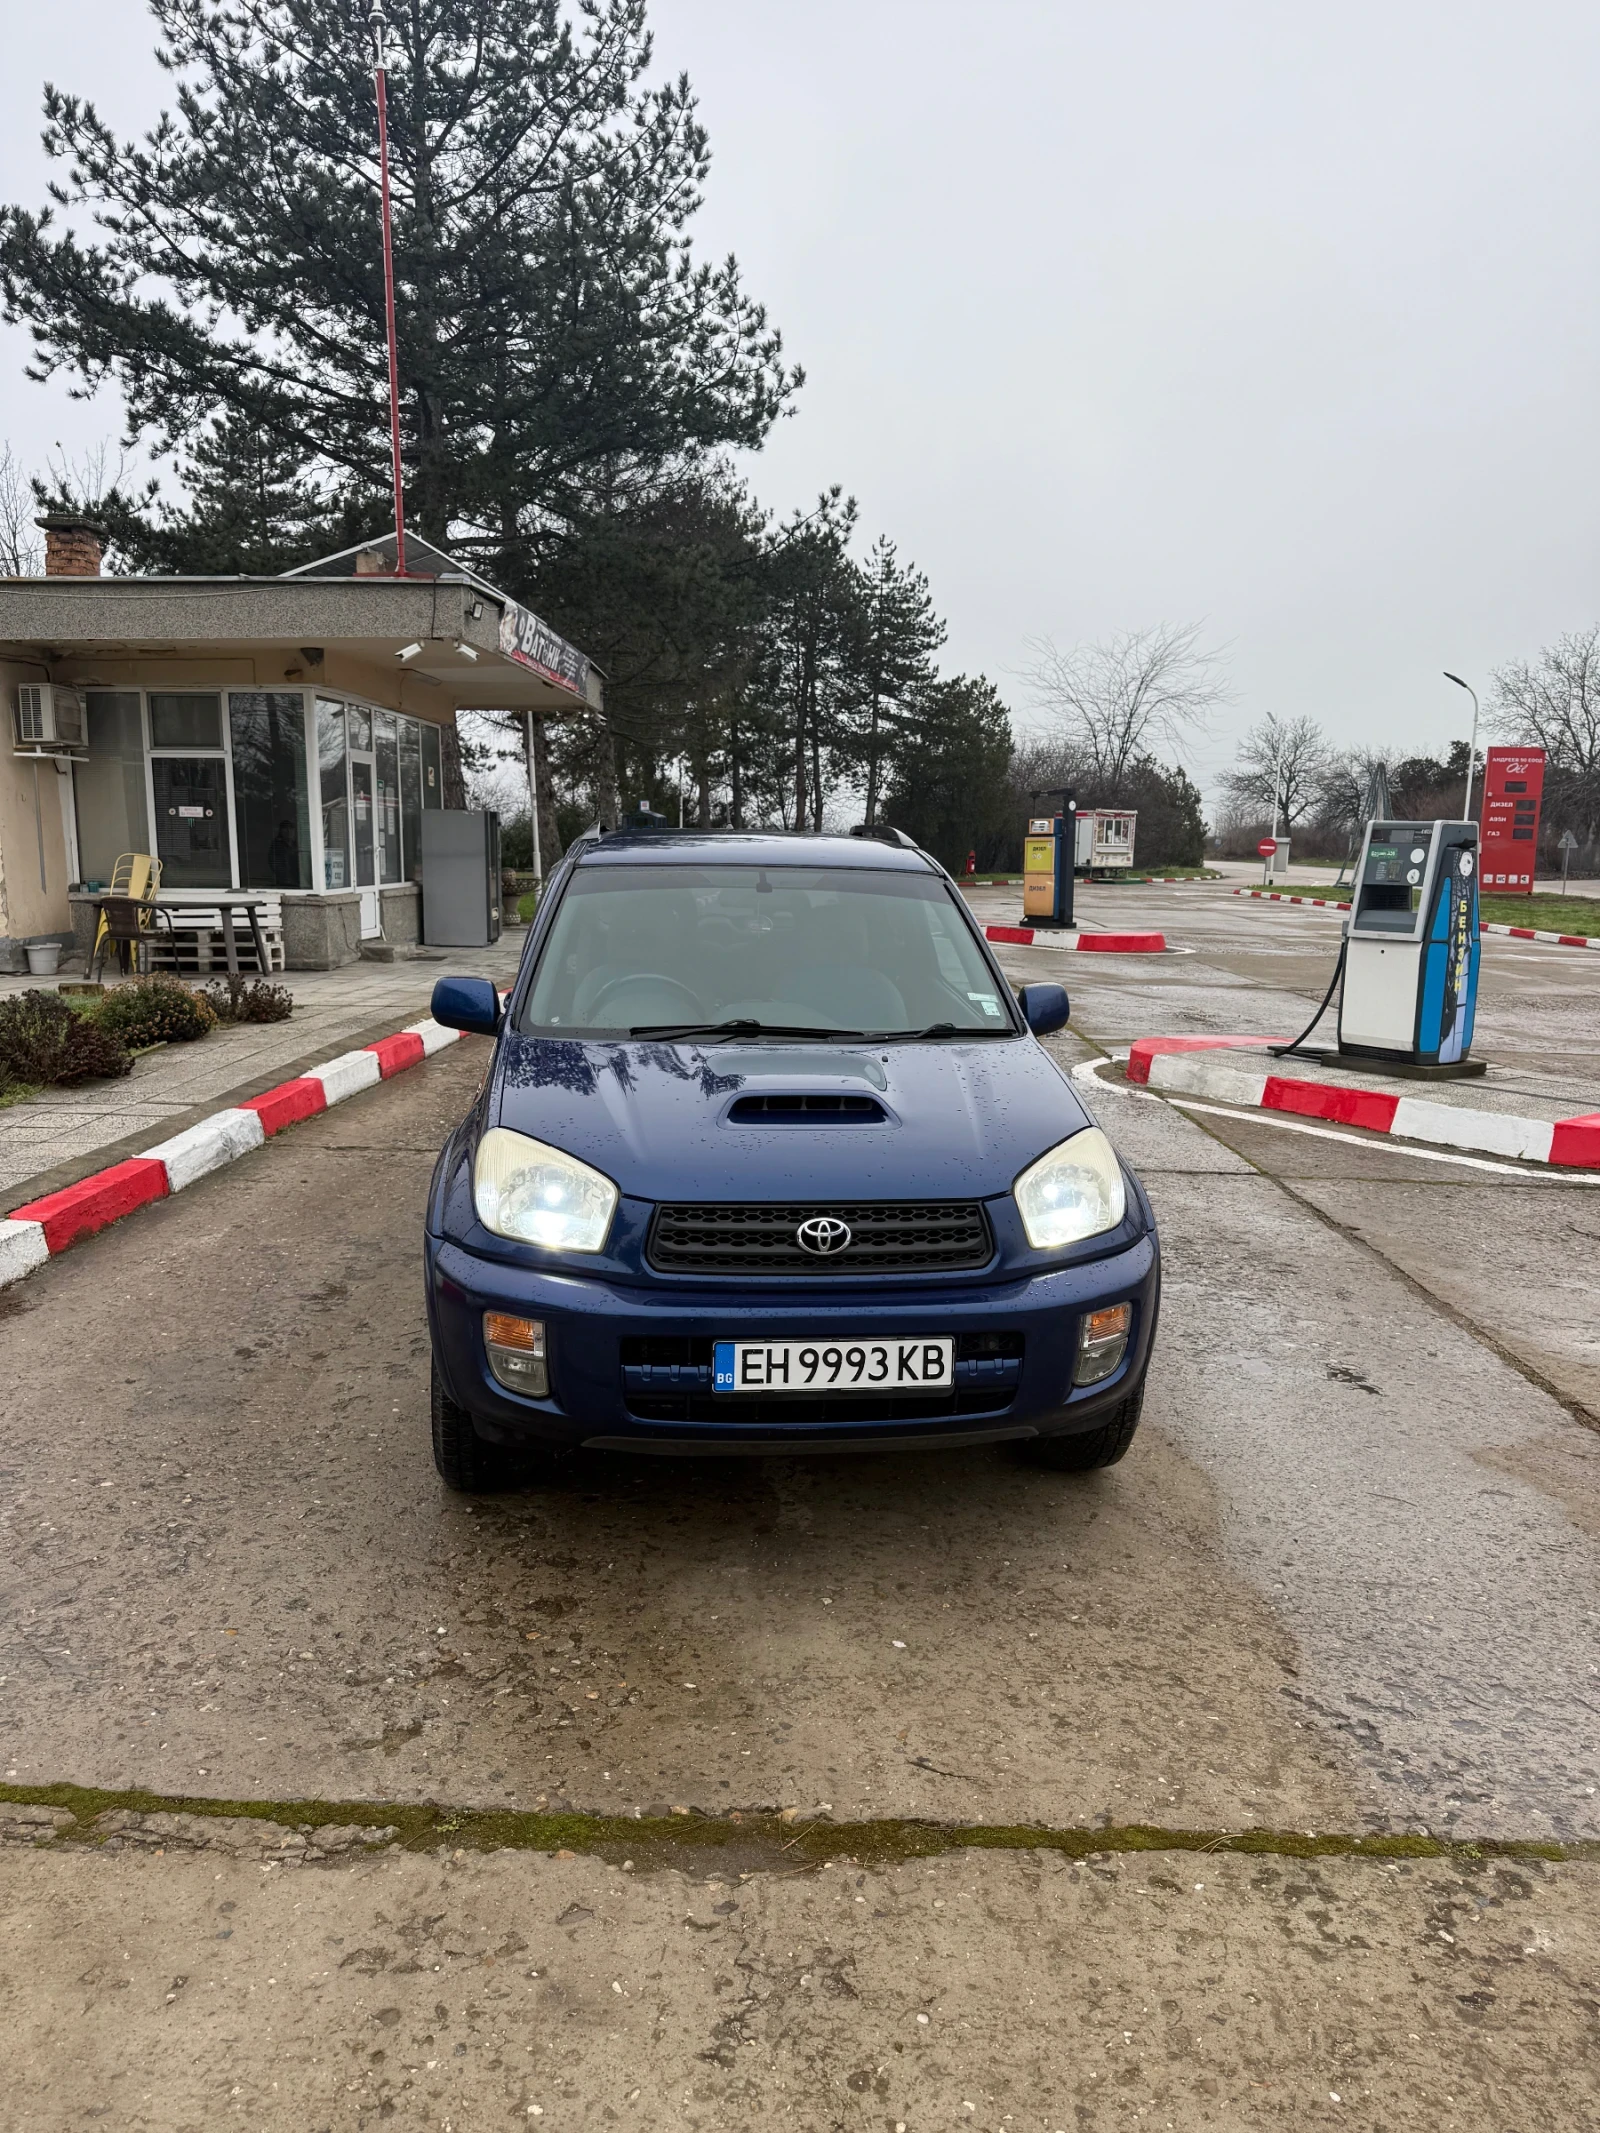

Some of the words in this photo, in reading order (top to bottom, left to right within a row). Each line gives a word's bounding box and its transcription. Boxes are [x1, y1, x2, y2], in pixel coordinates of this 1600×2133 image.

[1506, 762, 1529, 774] Oil
[1454, 899, 1468, 992] БЕНЗИН
[716, 1372, 733, 1383] BG
[741, 1348, 790, 1385] EH
[798, 1347, 889, 1384] 9993
[897, 1345, 946, 1381] KB
